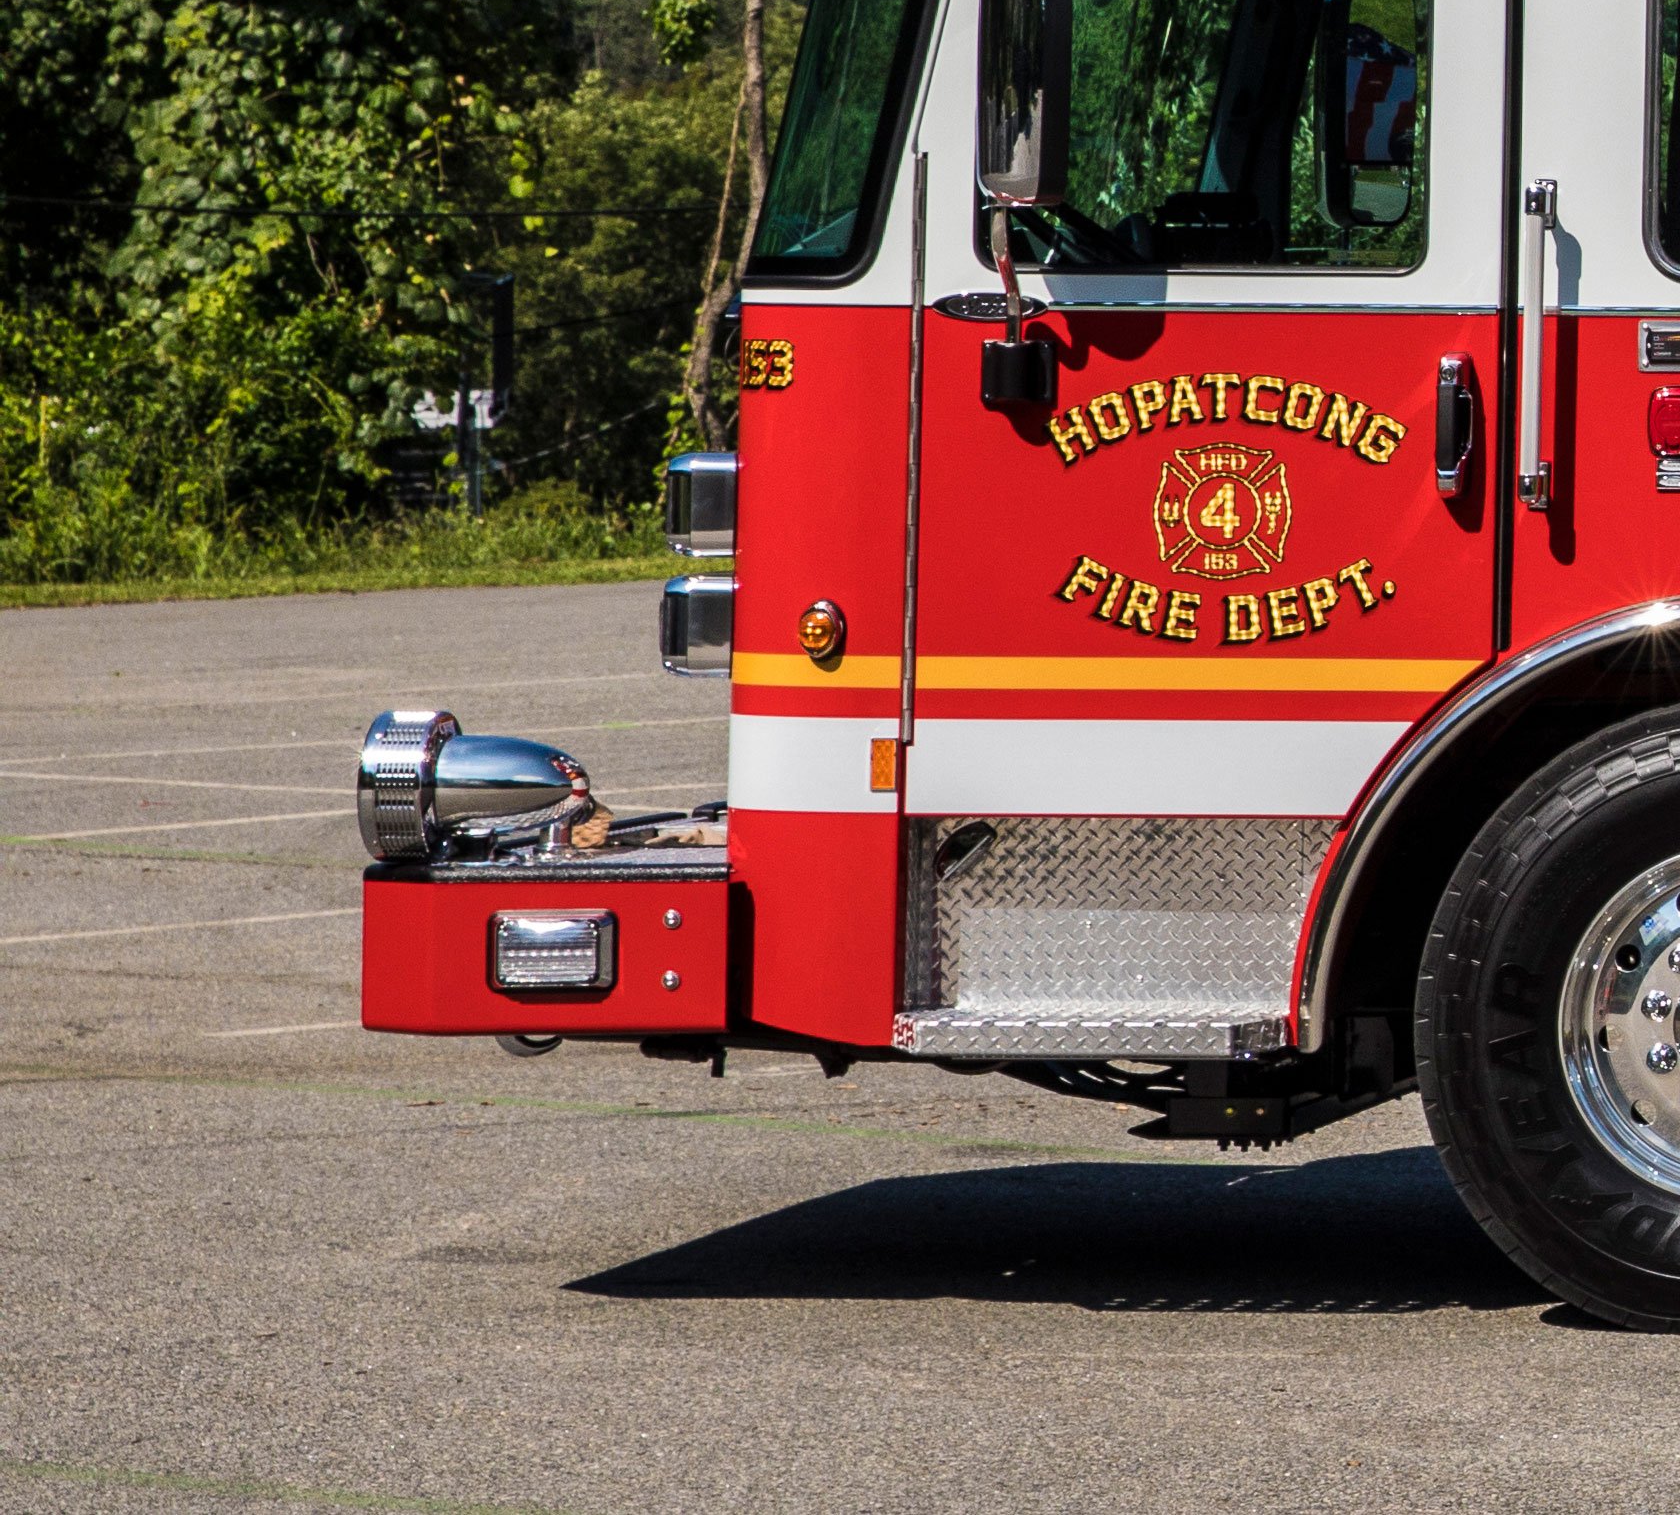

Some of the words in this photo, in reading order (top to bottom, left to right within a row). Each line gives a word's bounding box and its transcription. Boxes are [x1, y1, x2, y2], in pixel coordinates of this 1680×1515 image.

[1047, 372, 1410, 466] HOPATCONG
[1199, 453, 1248, 471] HFD
[1199, 482, 1241, 539] 4
[1203, 553, 1239, 571] 153
[1054, 554, 1204, 643] FIRE
[1222, 556, 1399, 645] DEPT.
